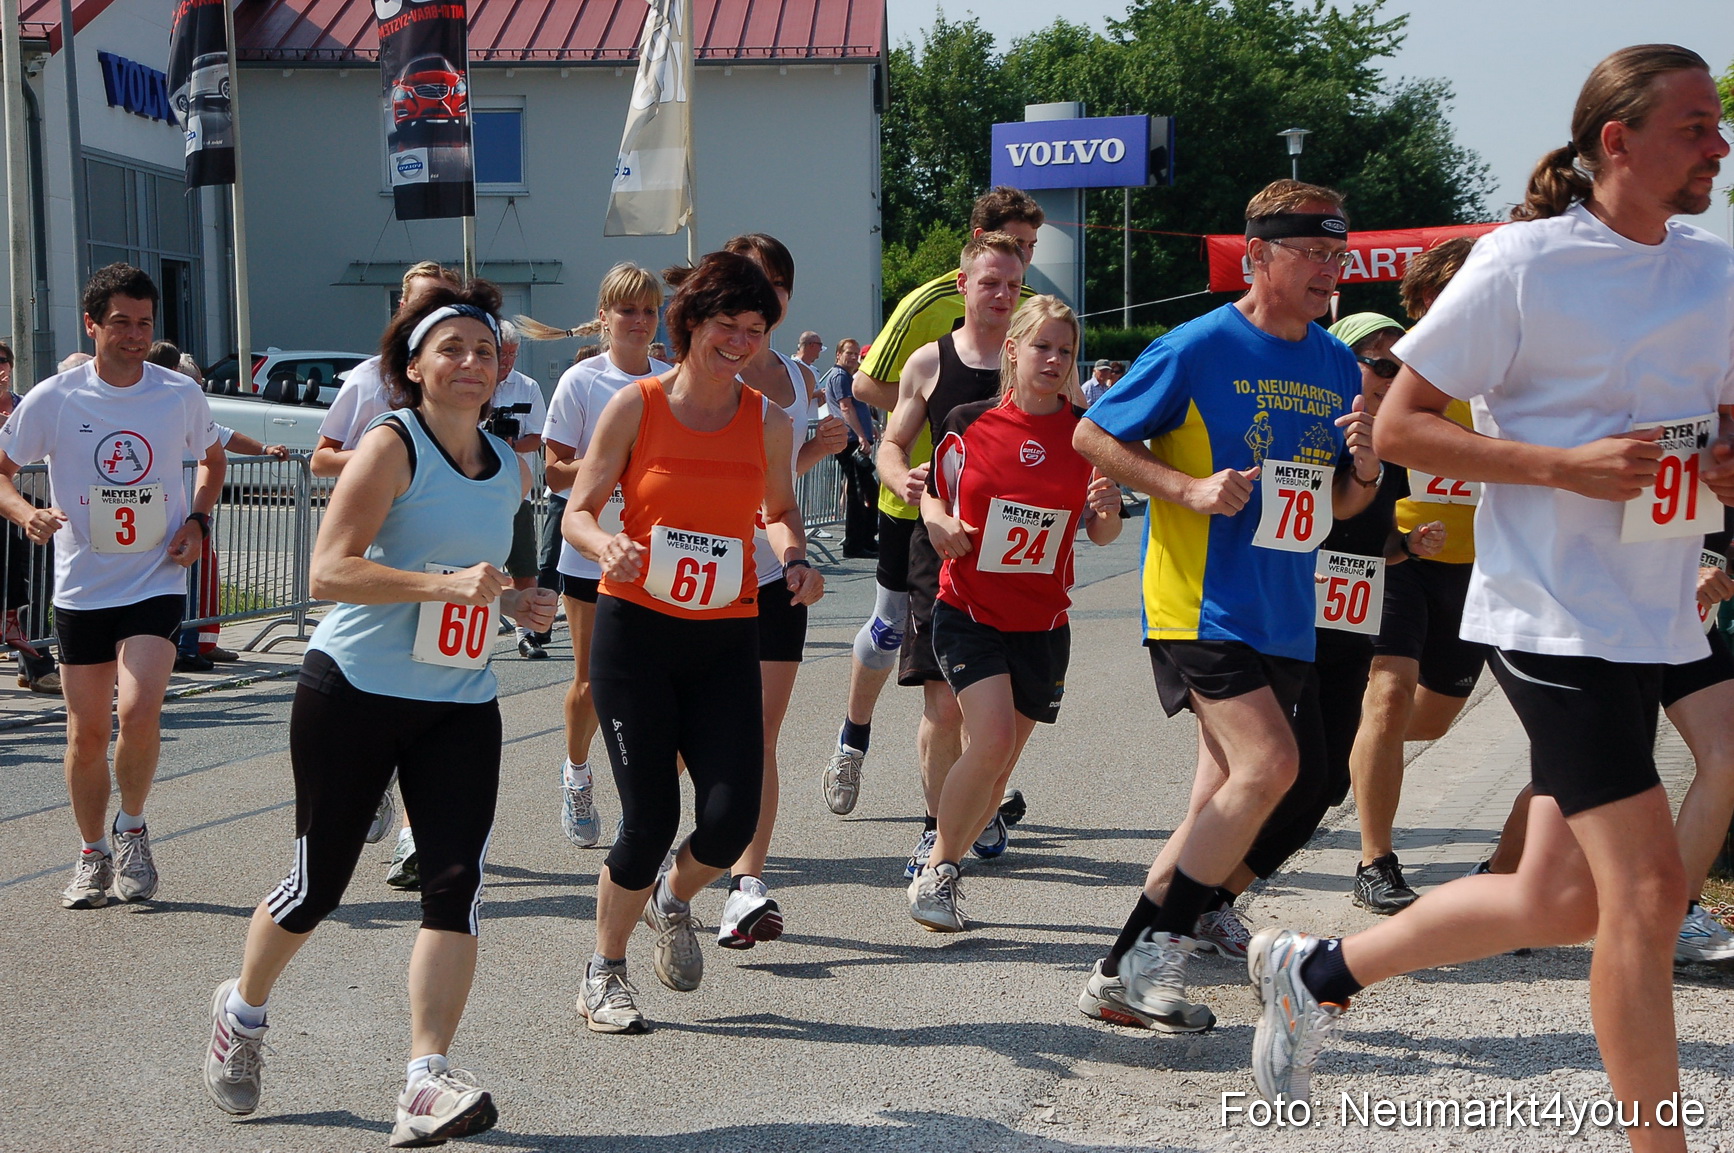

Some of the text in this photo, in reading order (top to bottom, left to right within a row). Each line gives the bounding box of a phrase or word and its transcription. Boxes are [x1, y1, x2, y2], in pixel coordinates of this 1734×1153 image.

[98, 50, 180, 127] VOLV
[1005, 138, 1126, 167] VOLVO
[1233, 379, 1343, 410] 10. NEUMARKTER
[1256, 394, 1332, 418] STADTLAUF
[1662, 423, 1695, 440] EYER
[1275, 465, 1310, 480] MEYER
[1275, 476, 1310, 488] WERBUNG
[1652, 453, 1699, 525] 91
[101, 488, 137, 498] MEYER
[101, 497, 138, 505] WERBUNG
[1002, 505, 1041, 520] MEYER
[1002, 513, 1040, 527] WERBUNG
[1275, 488, 1315, 542] 78
[114, 506, 137, 546] 3
[666, 530, 709, 547] MEYER
[666, 540, 710, 554] WERBUNG
[1001, 526, 1050, 565] 24
[1328, 554, 1366, 569] MEYER
[1700, 552, 1719, 567] EYER
[1328, 564, 1365, 576] WERBUNG
[670, 556, 718, 606] 61
[1323, 576, 1371, 625] 50
[438, 602, 490, 659] 60
